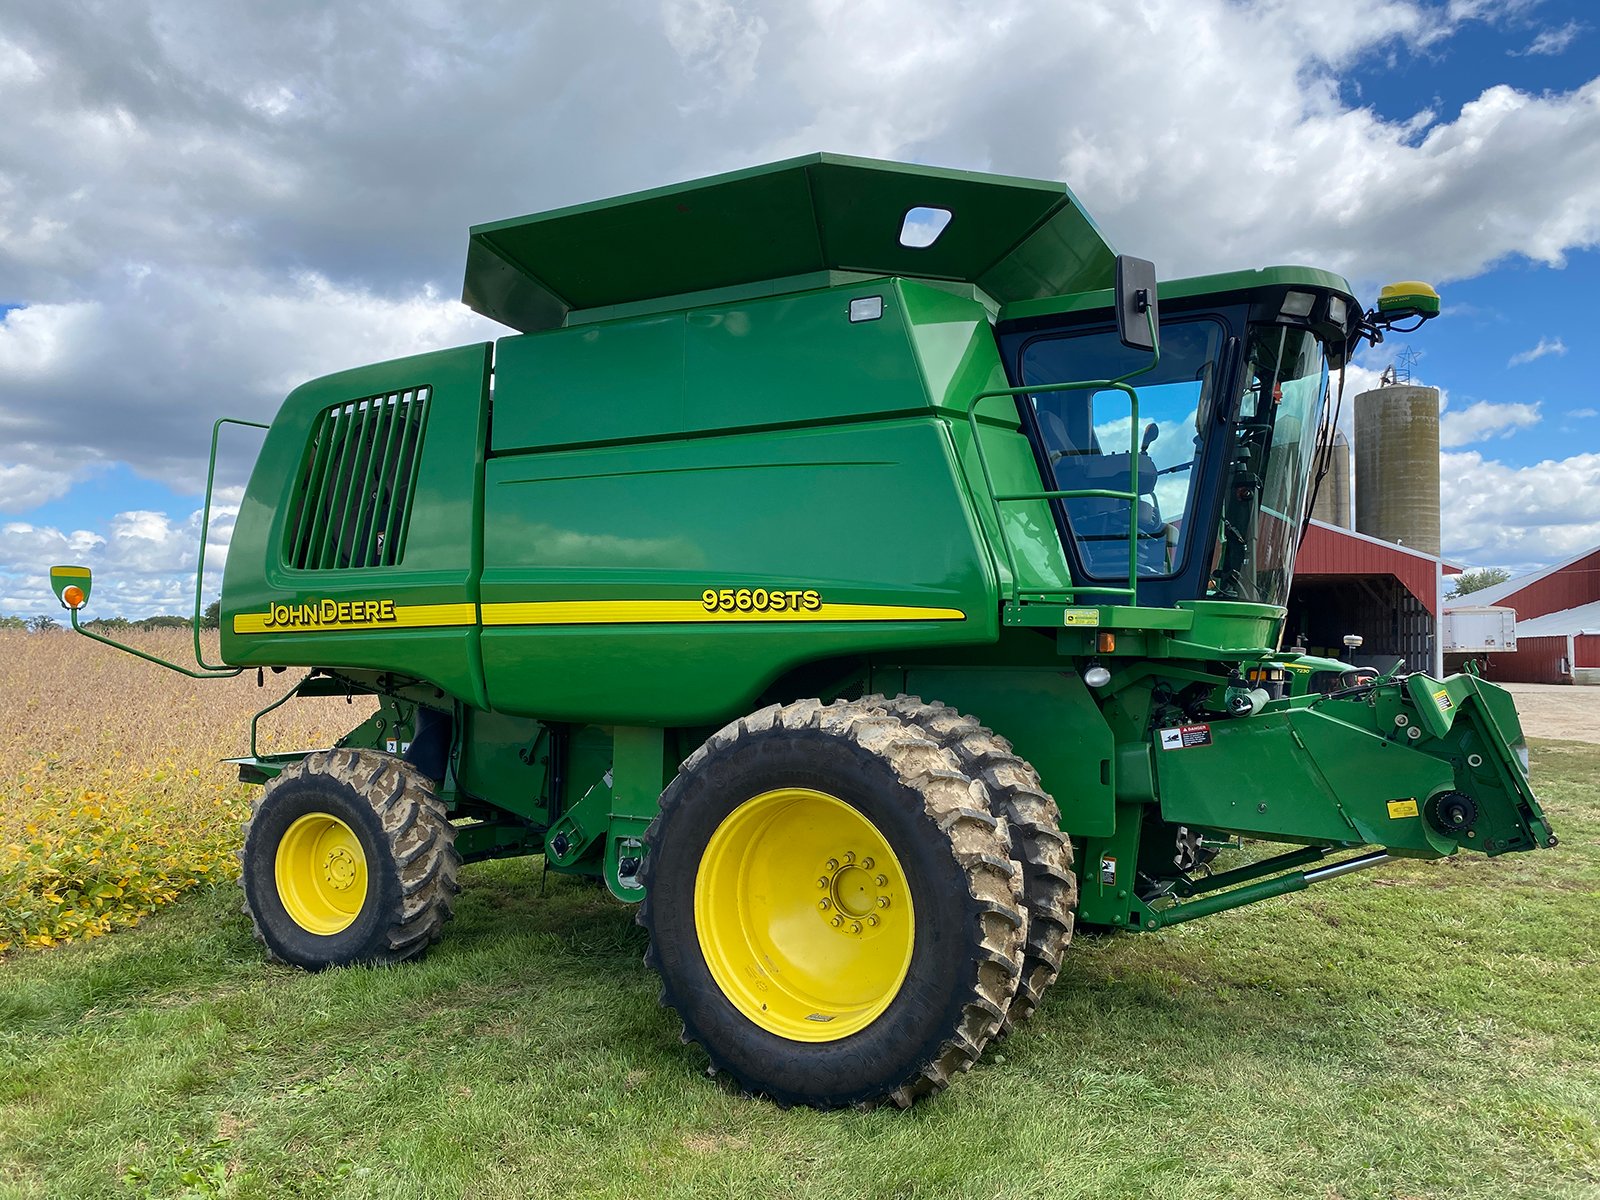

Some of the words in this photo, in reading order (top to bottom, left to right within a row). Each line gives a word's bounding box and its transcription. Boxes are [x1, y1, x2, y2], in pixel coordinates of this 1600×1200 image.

[264, 602, 319, 626] JOHN
[320, 599, 395, 624] DEERE
[702, 587, 822, 612] 9560STS
